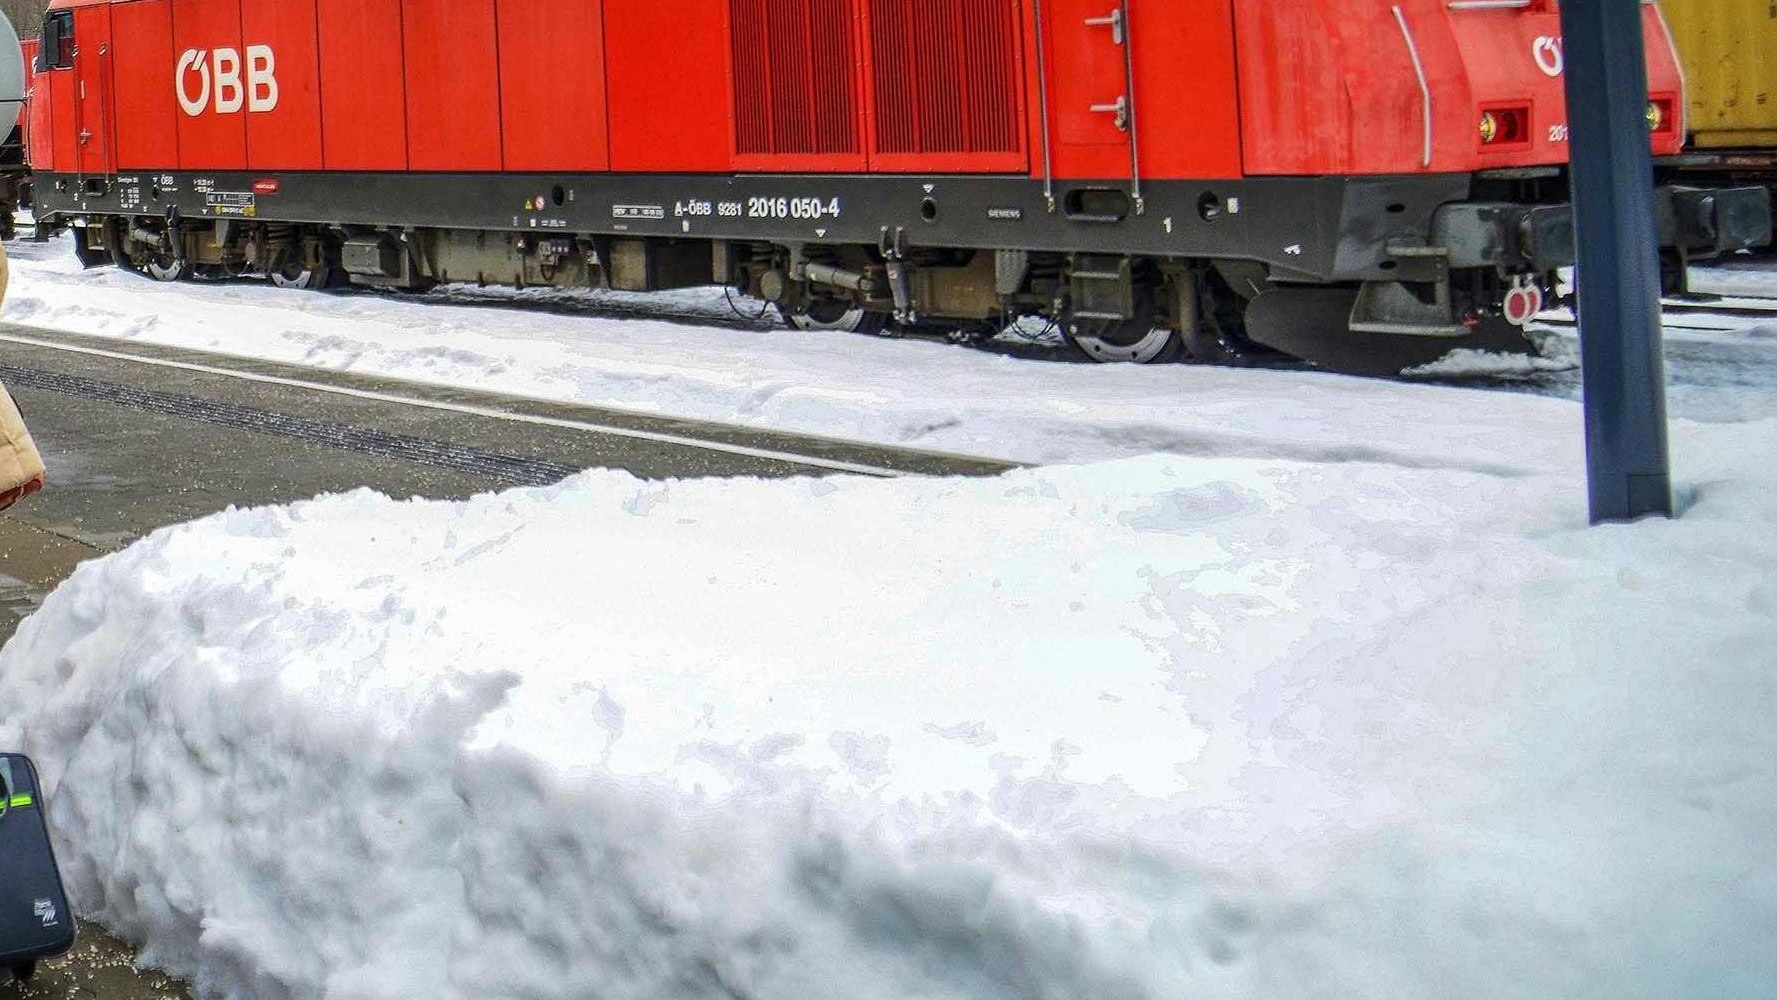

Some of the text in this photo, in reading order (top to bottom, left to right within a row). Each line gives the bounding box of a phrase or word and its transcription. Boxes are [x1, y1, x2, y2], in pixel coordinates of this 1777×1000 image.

[175, 44, 279, 117] ÖBB
[674, 199, 712, 217] A-ÖBB
[717, 202, 743, 217] 9281
[748, 197, 788, 218] 2016
[790, 197, 840, 219] 050-4
